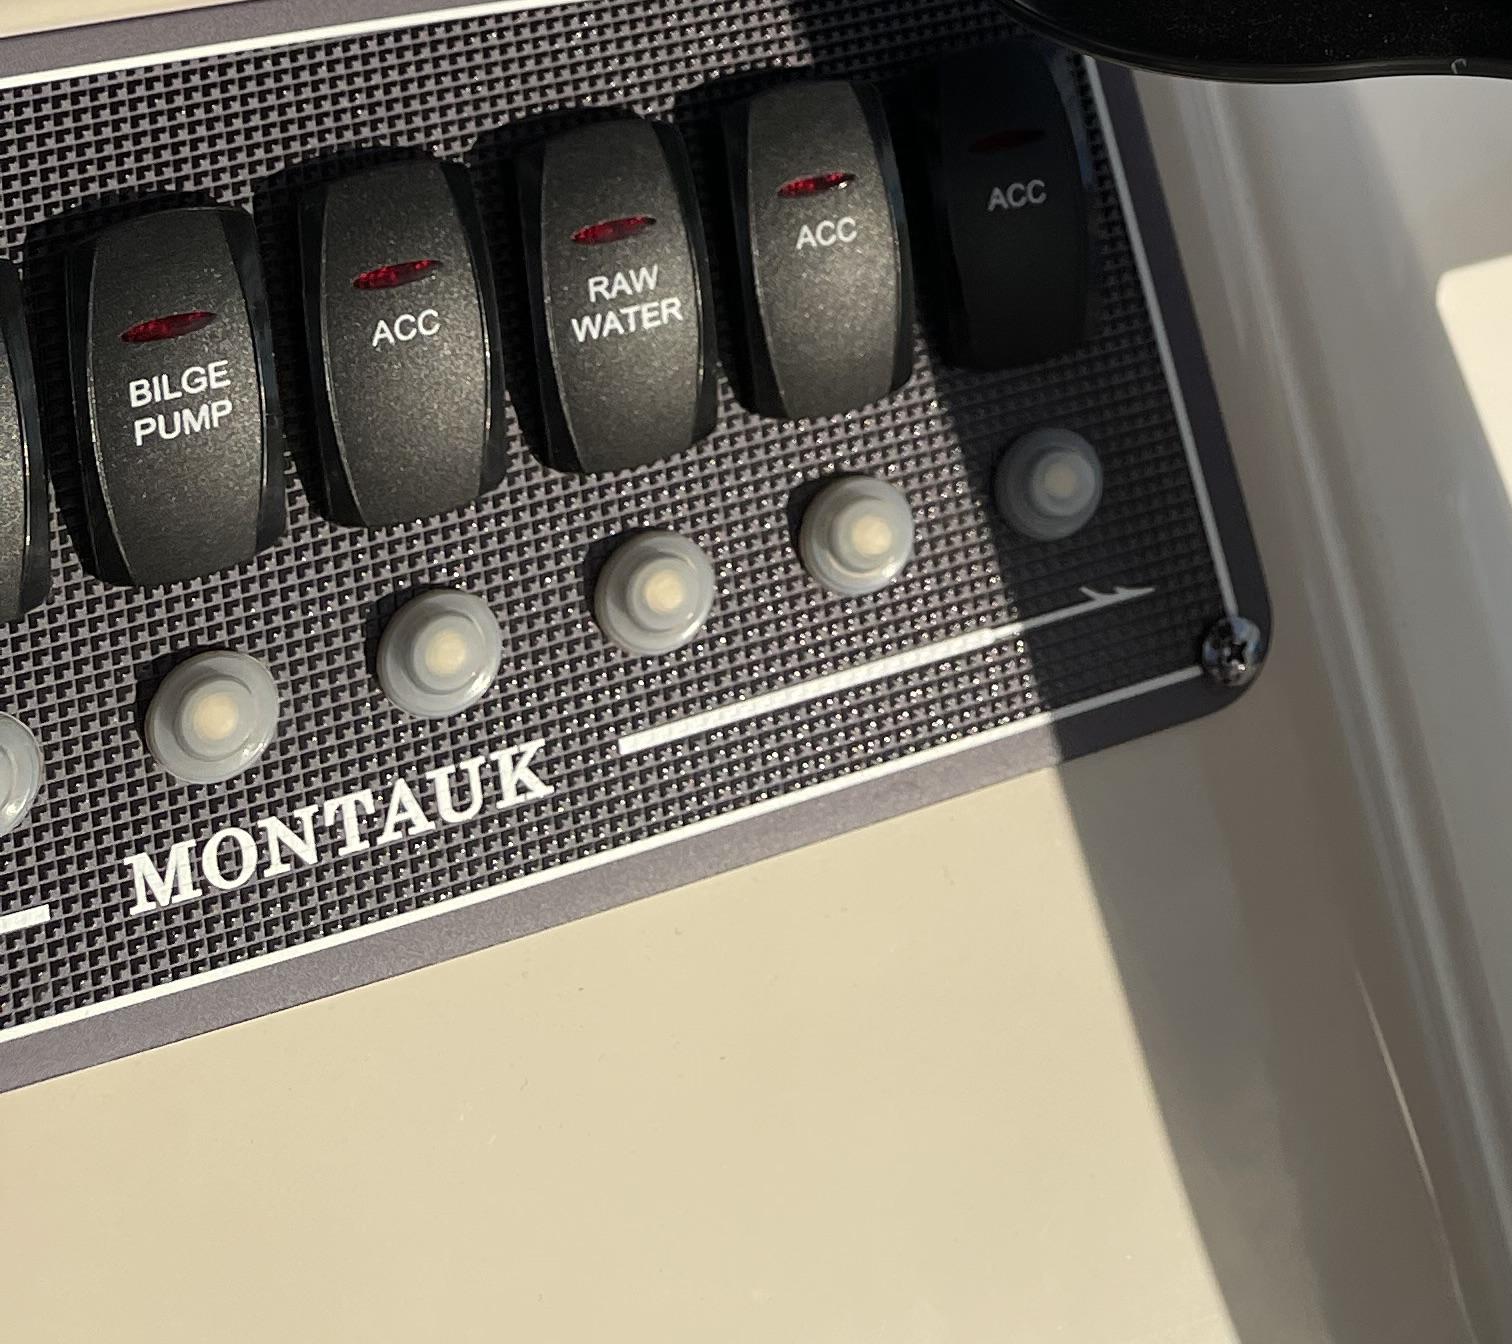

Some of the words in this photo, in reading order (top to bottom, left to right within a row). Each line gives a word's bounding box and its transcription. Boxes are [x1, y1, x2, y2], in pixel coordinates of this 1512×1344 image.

[986, 179, 1048, 212] ACC
[795, 216, 858, 250] ACC
[587, 263, 660, 303] RAW
[370, 308, 441, 348] ACC
[570, 297, 683, 343] WATER
[128, 359, 231, 409] BILGE
[133, 398, 233, 447] PUMP
[123, 737, 555, 917] MONTAUK
